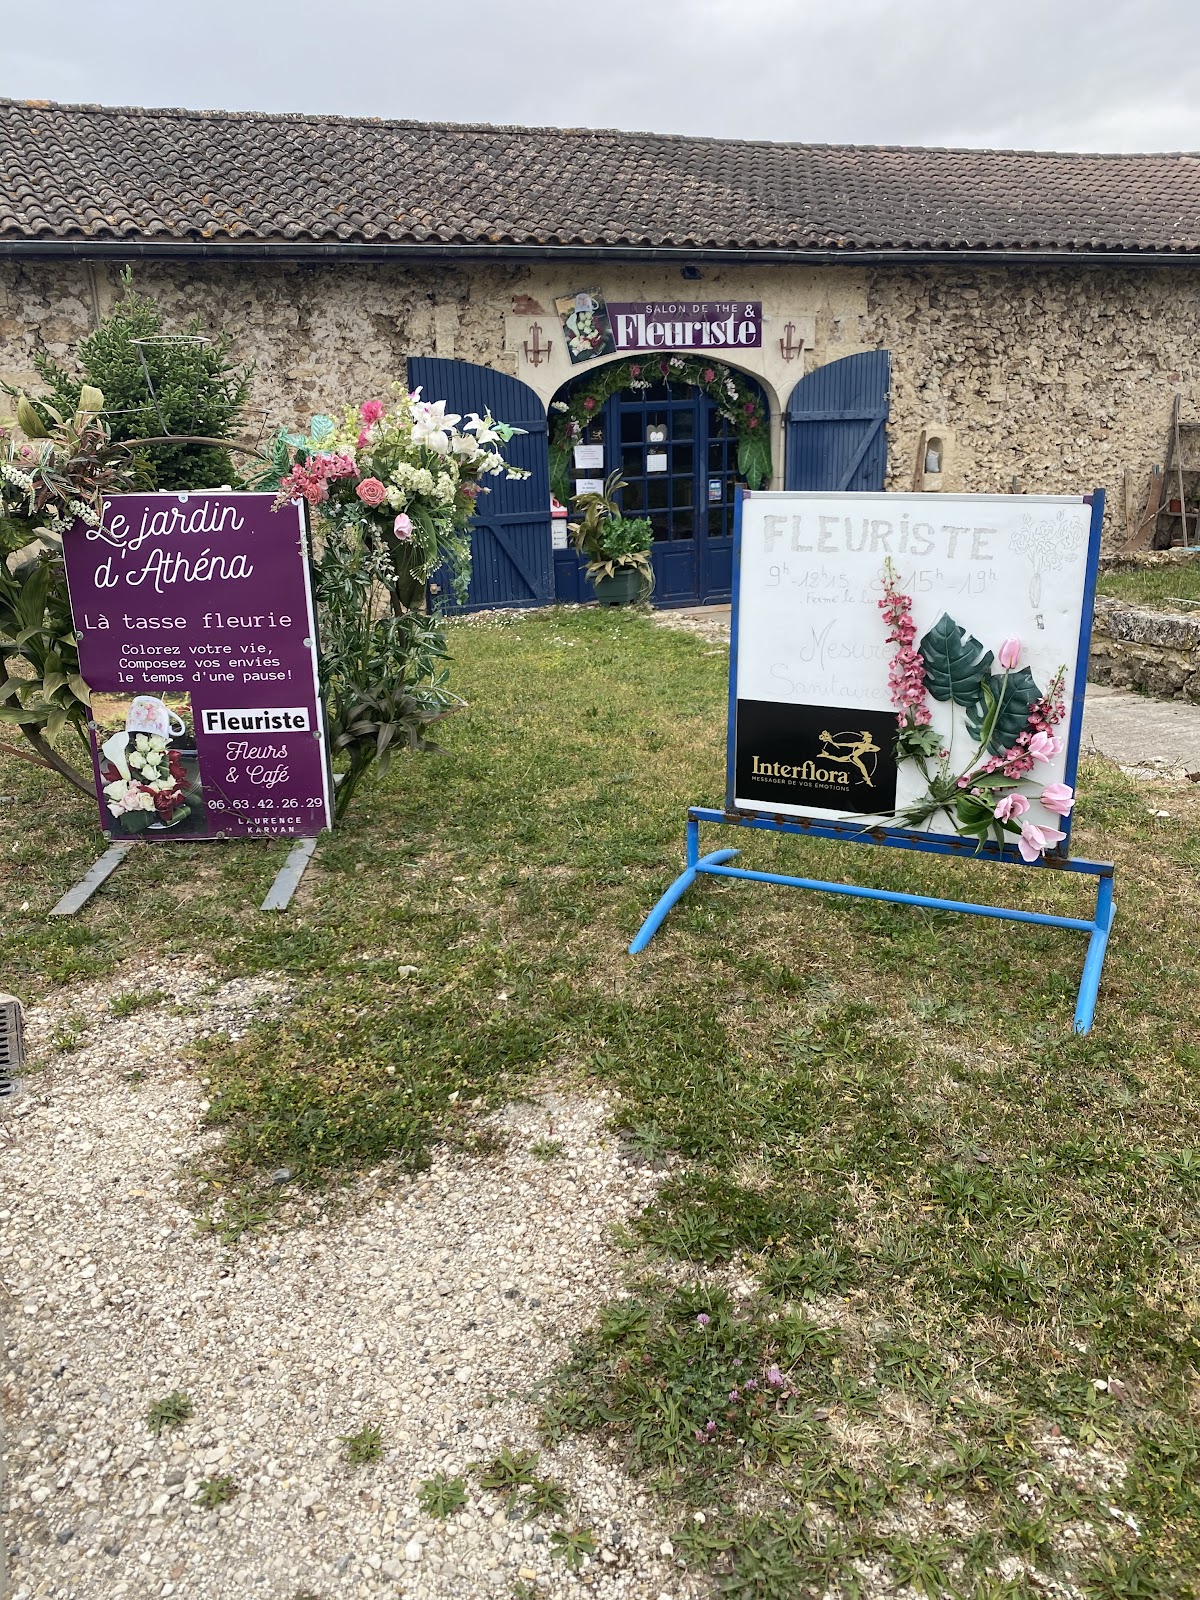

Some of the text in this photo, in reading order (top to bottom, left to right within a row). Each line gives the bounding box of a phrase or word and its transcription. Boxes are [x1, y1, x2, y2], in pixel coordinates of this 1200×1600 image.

[645, 303, 755, 318] SALON DE THE &
[615, 313, 757, 347] Fleuriste
[85, 500, 244, 550] Le jardin
[94, 548, 253, 594] d'Athéna
[84, 611, 292, 630] Là tasse fleurie
[121, 642, 273, 655] Colorez votre vie,
[119, 655, 280, 671] Composez vos envies
[118, 669, 293, 685] le temps d'une pause!
[205, 709, 305, 731] Fleuriste
[225, 741, 288, 761] Fleurs
[225, 764, 290, 789] & Café
[752, 756, 850, 784] Interflora
[751, 775, 786, 785] MESSAGER
[208, 797, 323, 810] 06.63.42.26.29
[238, 816, 302, 825] LAURENCE
[247, 825, 295, 834] KARVAN
